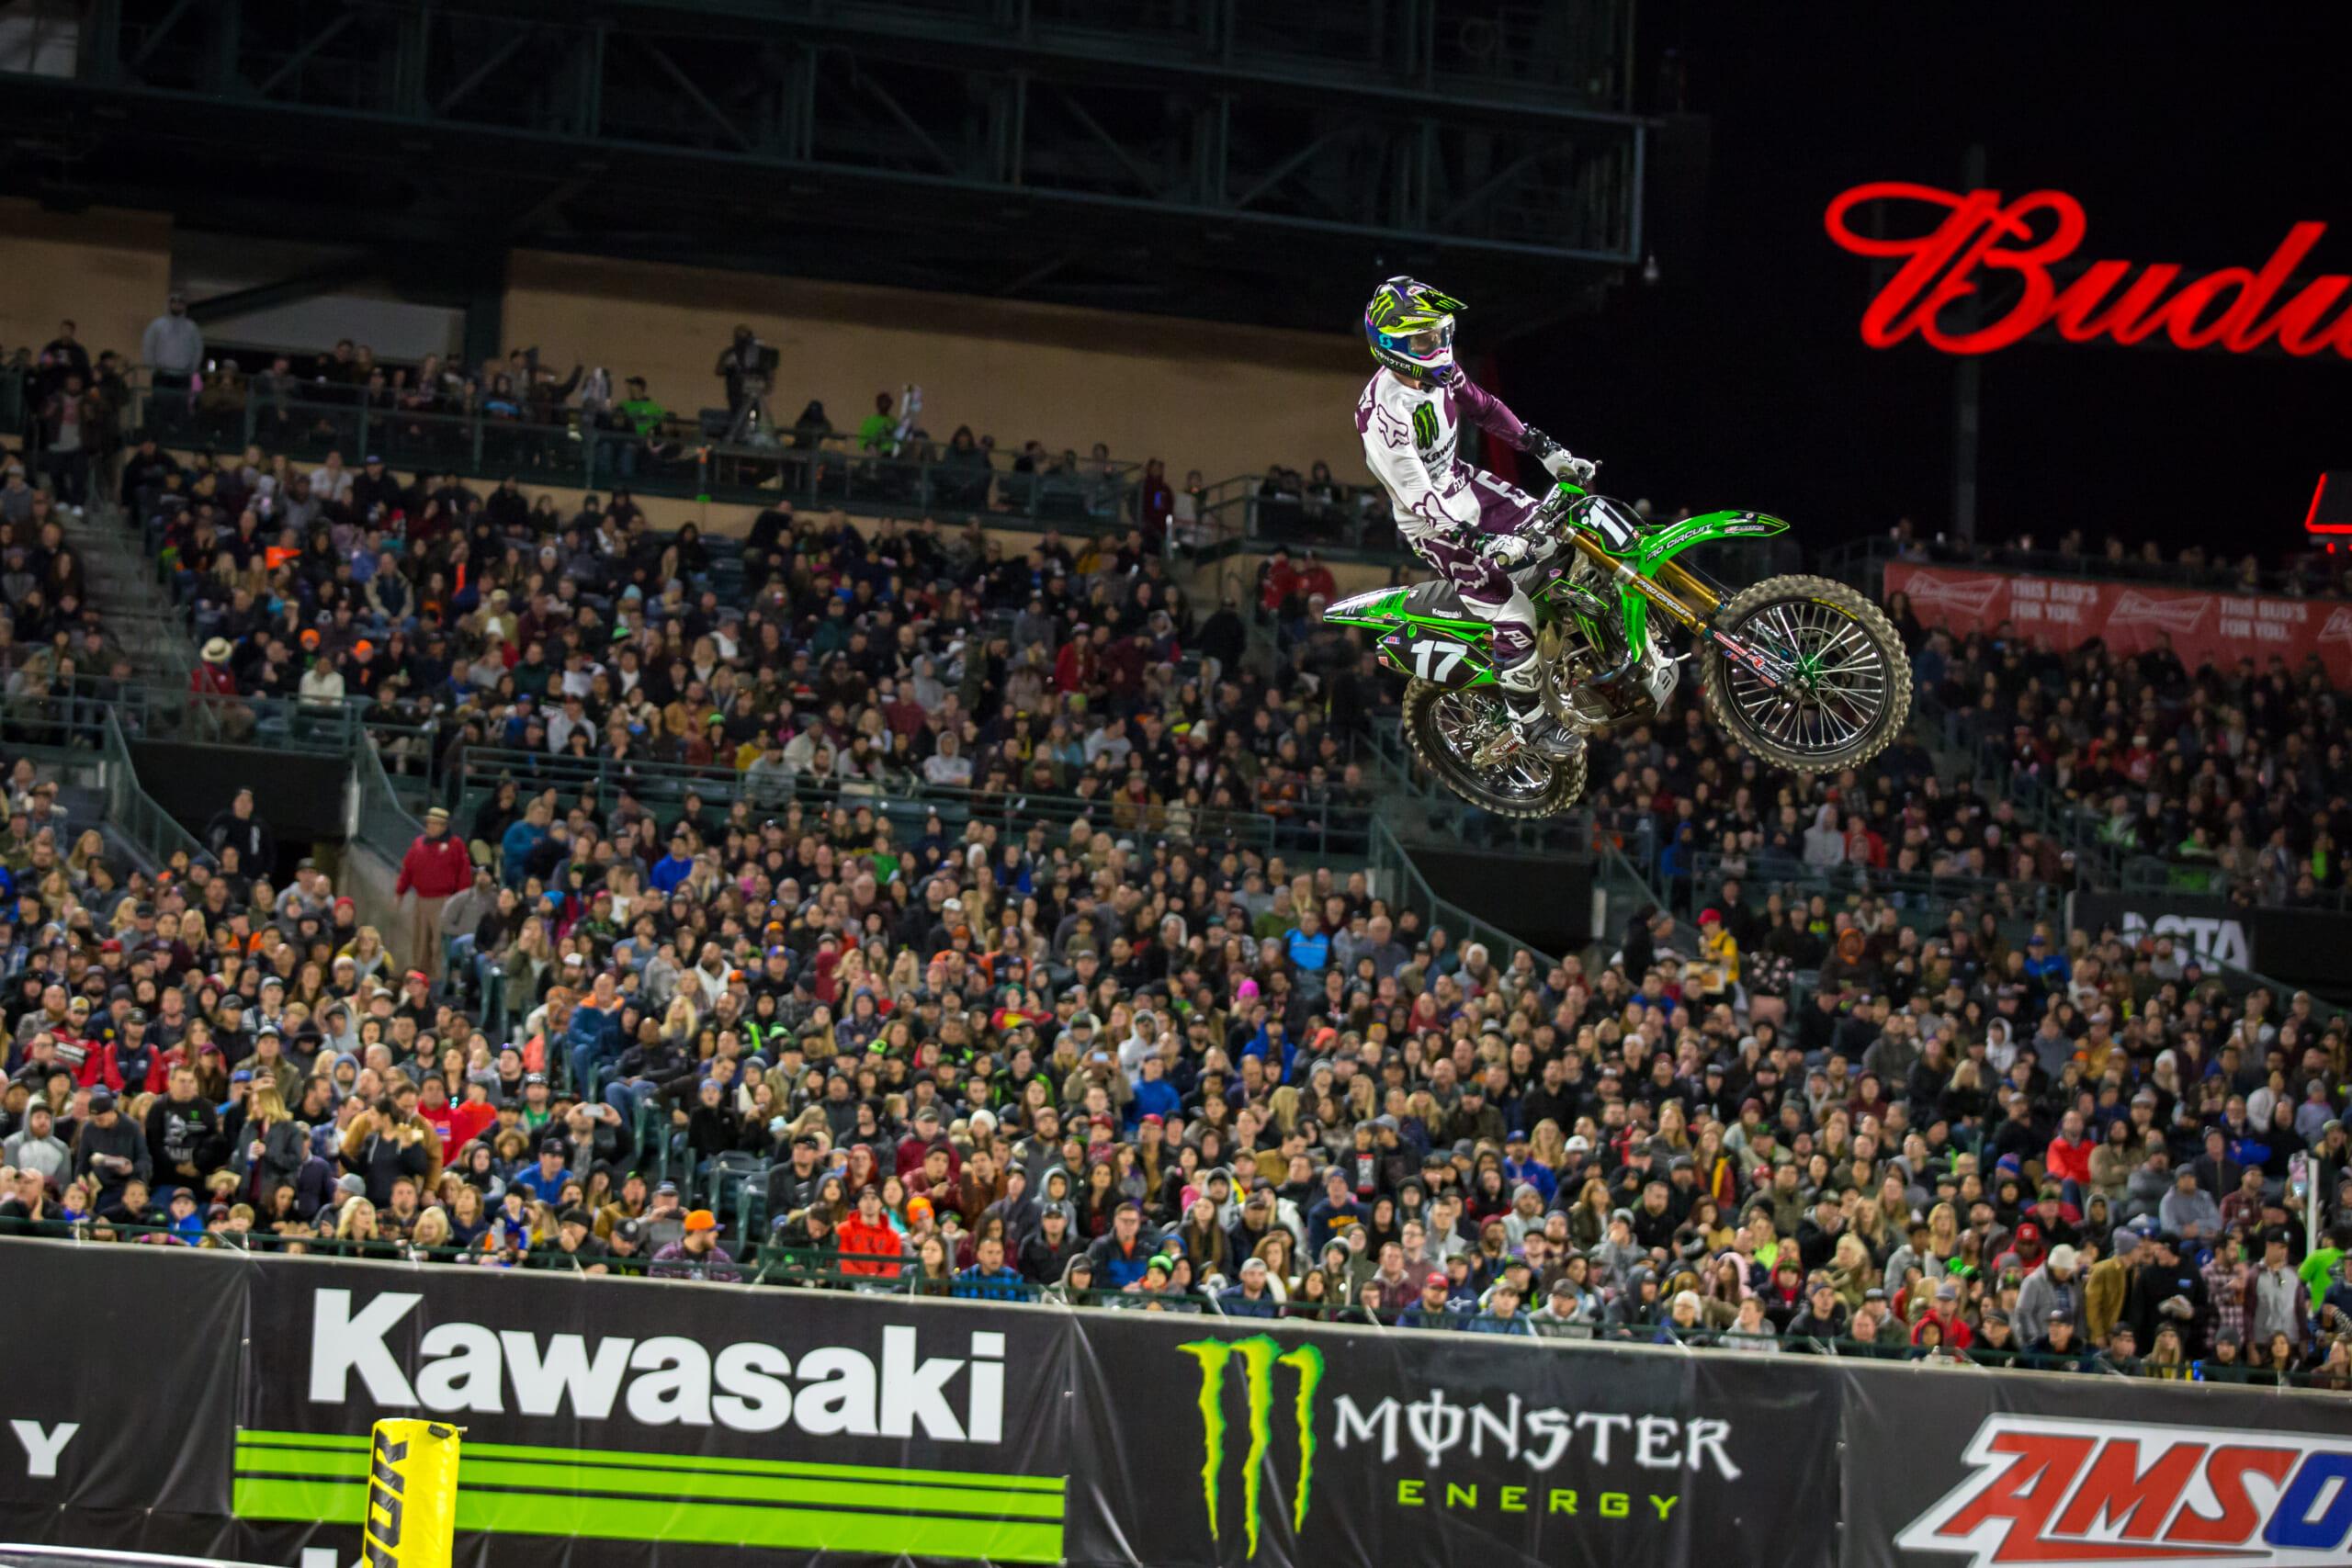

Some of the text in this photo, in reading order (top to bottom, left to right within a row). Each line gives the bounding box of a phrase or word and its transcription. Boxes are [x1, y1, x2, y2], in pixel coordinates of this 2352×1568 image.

[1589, 497, 1634, 547] 17
[1646, 546, 1664, 562] PRO
[1667, 523, 1713, 549] CIRCUIT
[1637, 580, 1657, 595] PRO
[1656, 590, 1693, 618] CIRCUIT
[2010, 600, 2042, 620] FOR
[2219, 618, 2251, 638] FOR
[1410, 639, 1468, 682] 17
[309, 1288, 1006, 1444] Kawasaki
[10, 1419, 81, 1477] Y
[1333, 1388, 1742, 1481] MONSTER
[1396, 1479, 1679, 1521] ENERGY
